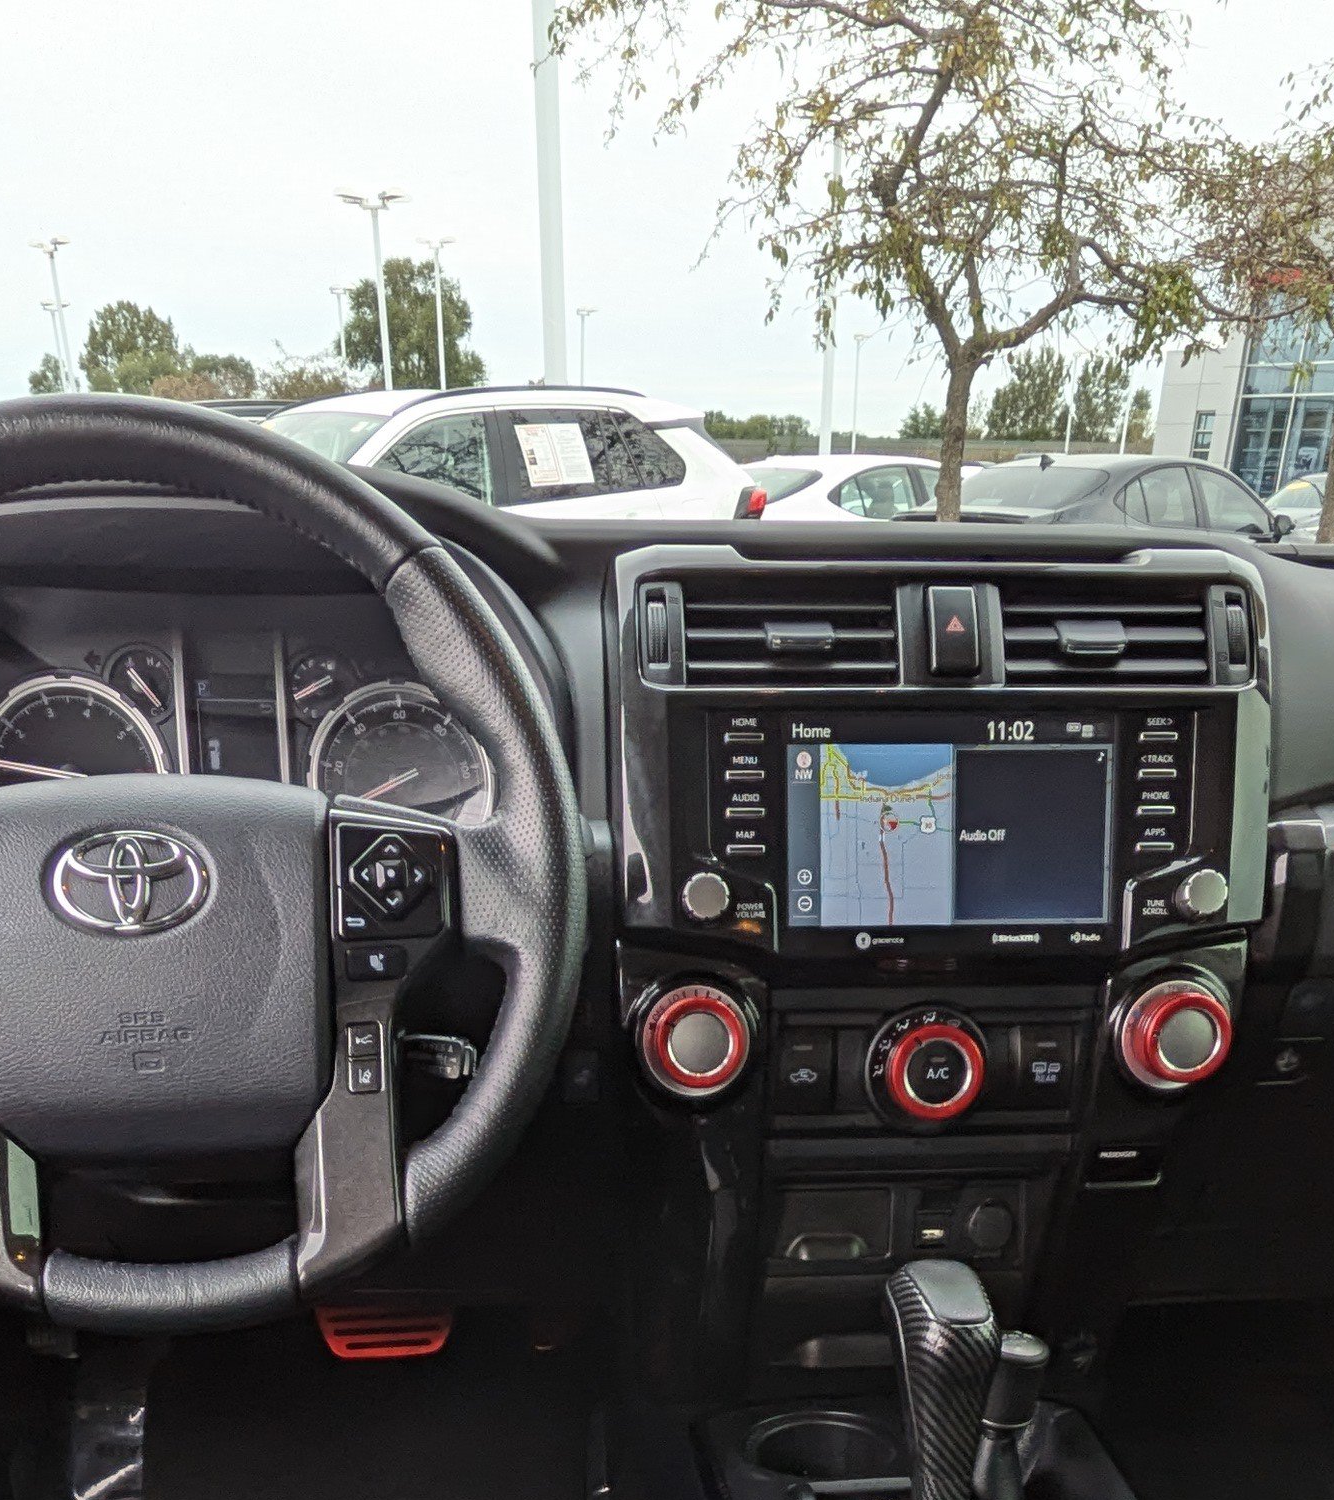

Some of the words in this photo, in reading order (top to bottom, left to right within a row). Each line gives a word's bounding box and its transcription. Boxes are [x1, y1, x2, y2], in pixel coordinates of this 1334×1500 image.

[47, 708, 56, 719] 3
[82, 708, 92, 719] 4
[392, 709, 407, 720] 60
[731, 717, 758, 727] HOME
[353, 722, 367, 736] 40
[791, 722, 832, 739] Home
[986, 721, 1035, 742] 11:02
[732, 756, 758, 765] MENU
[794, 769, 814, 781] NW
[731, 793, 760, 803] AUDIO
[1141, 791, 1170, 801] PHONE
[735, 830, 756, 840] MAP
[959, 829, 987, 842] Audio
[989, 829, 1006, 842] Off
[1144, 828, 1166, 837] APPS
[1146, 899, 1165, 908] TUNE
[735, 911, 766, 919] VOLUME
[1142, 907, 1169, 916] SCROLL
[926, 1066, 950, 1080] A/C
[1034, 1074, 1057, 1083] REAR
